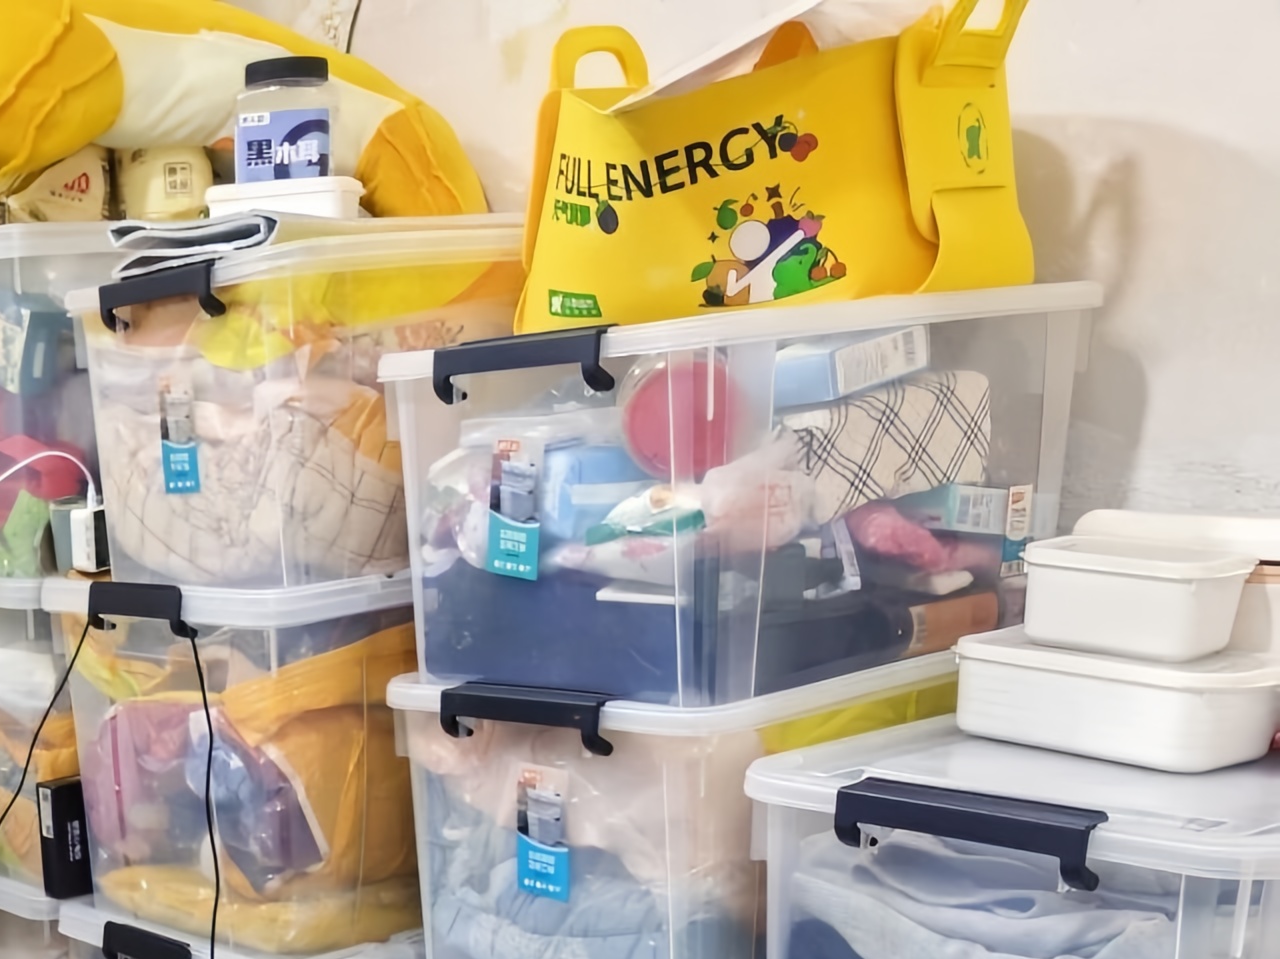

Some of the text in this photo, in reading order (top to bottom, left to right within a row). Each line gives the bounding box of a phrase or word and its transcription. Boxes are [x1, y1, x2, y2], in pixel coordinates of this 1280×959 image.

[246, 138, 320, 168] 黑木耳
[556, 114, 784, 201] FULL ENERGY
